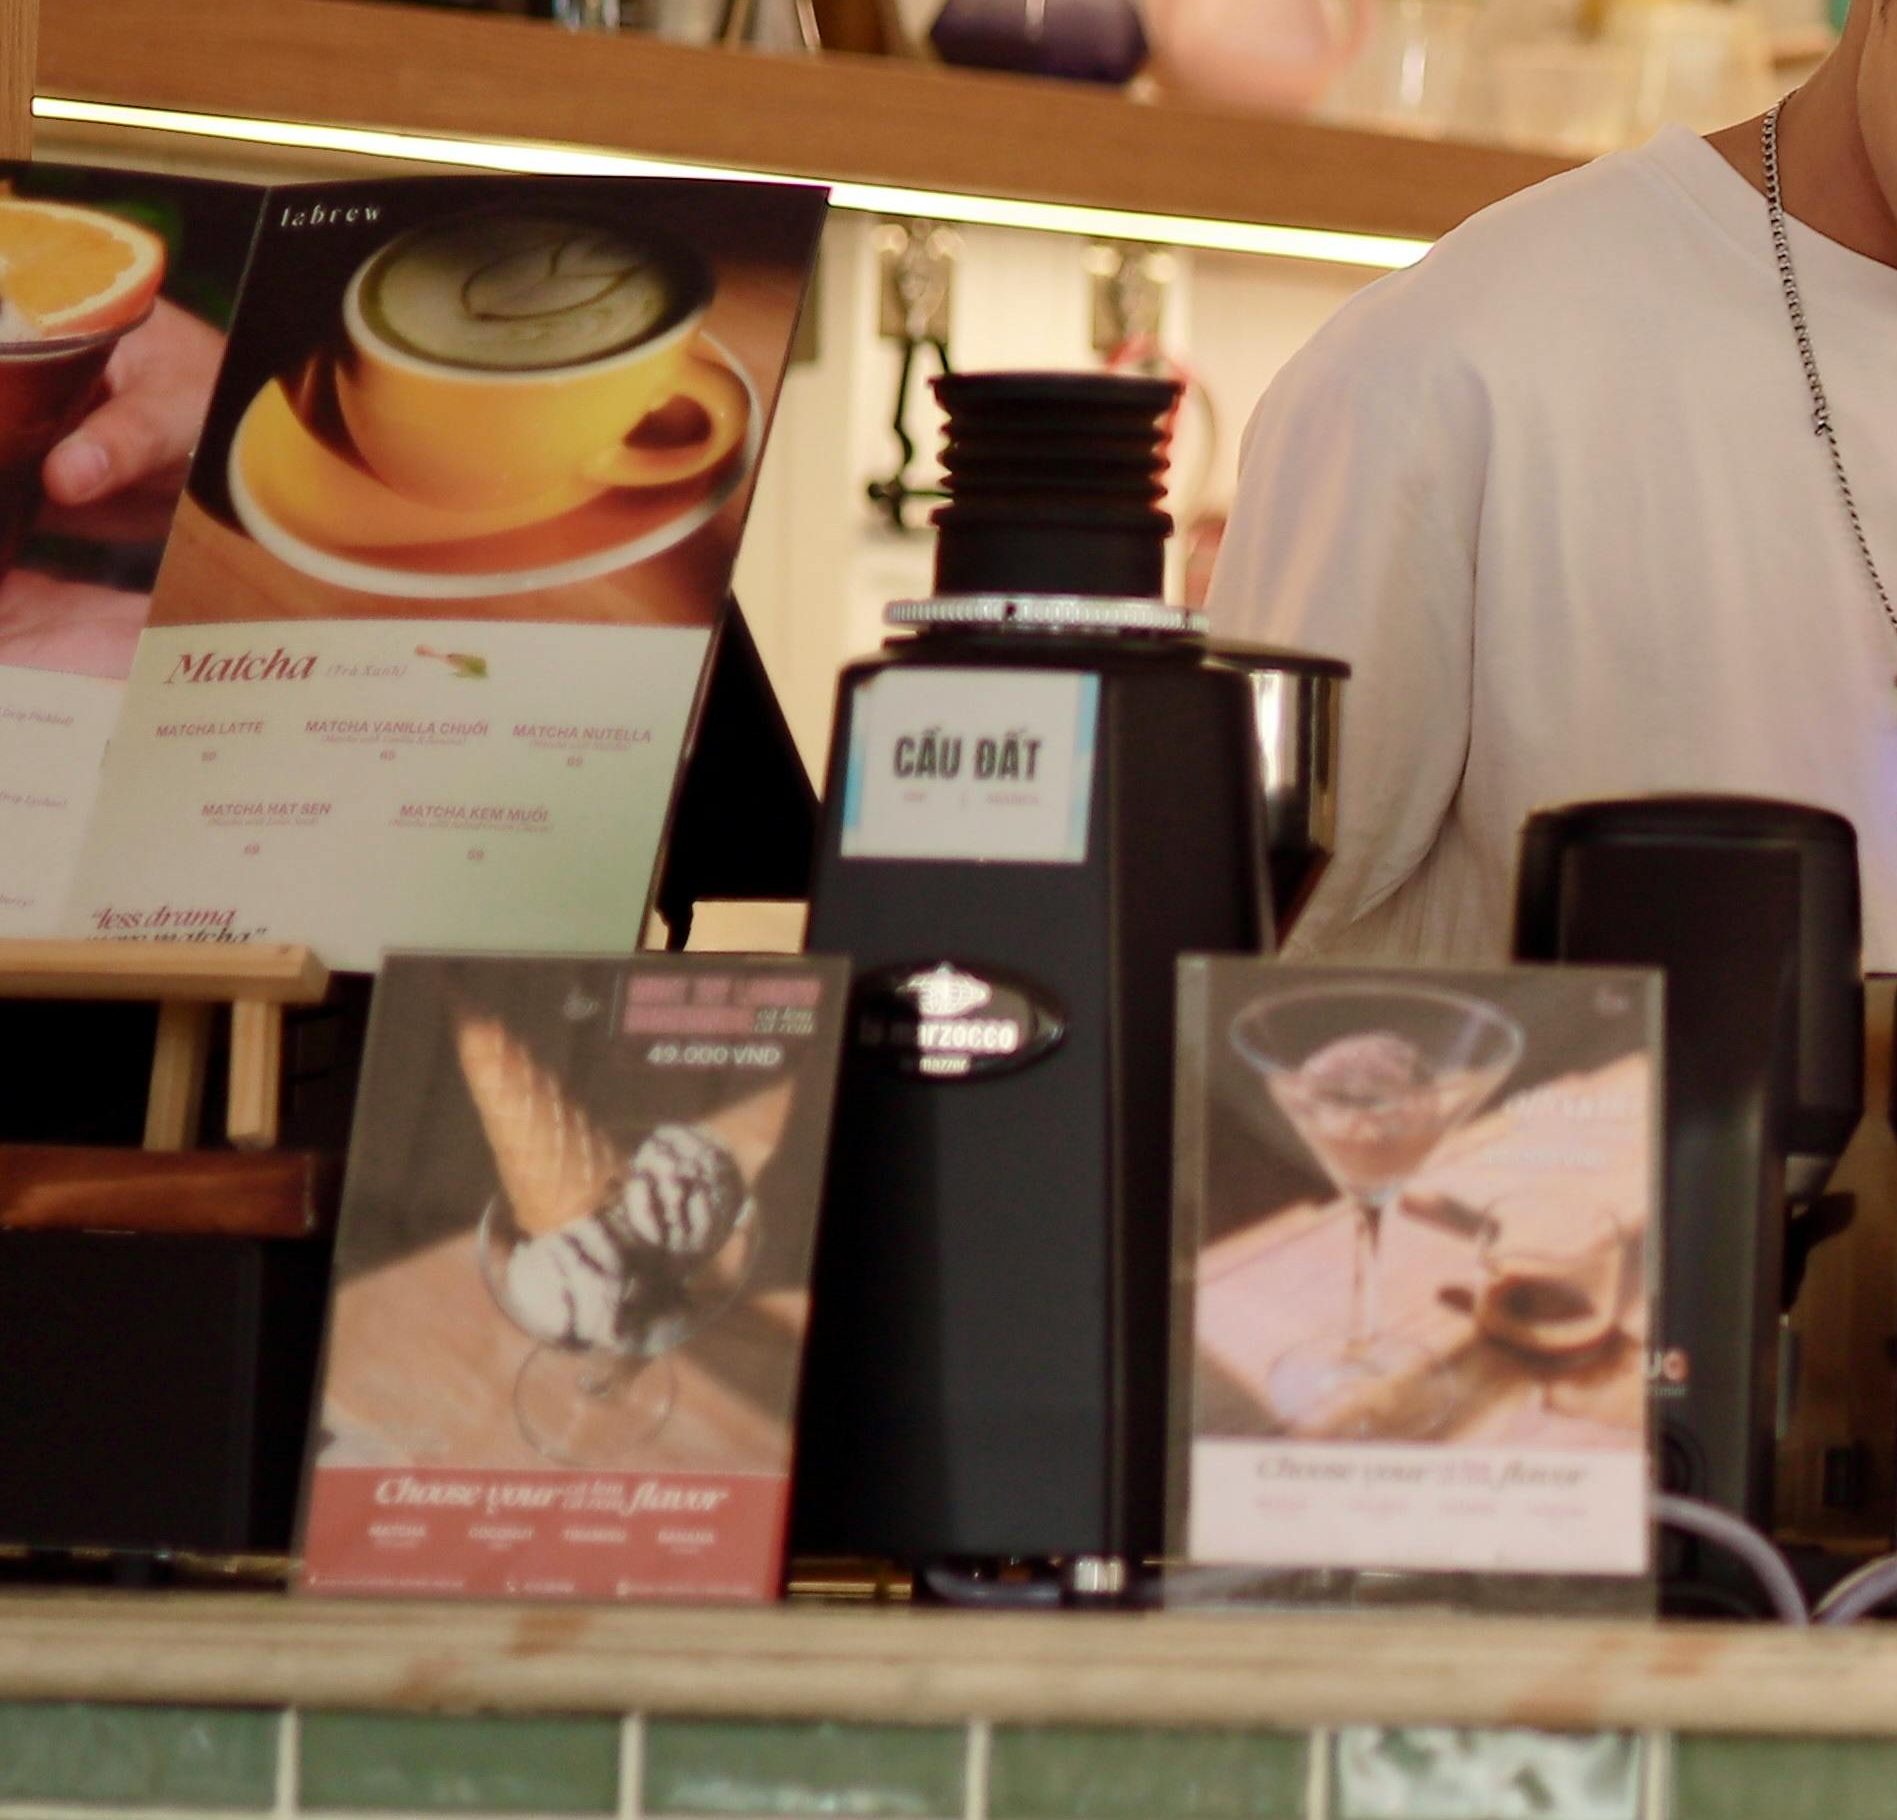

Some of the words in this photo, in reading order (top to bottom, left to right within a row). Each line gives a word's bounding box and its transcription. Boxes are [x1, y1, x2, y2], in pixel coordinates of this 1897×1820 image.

[281, 204, 380, 227] labrew
[162, 647, 319, 684] Matcha
[156, 722, 217, 737] MATCHA
[219, 720, 264, 734] LATTE
[305, 720, 368, 733] MATCHA
[374, 722, 436, 735] VANILLA
[512, 724, 578, 739] MATCHA
[583, 727, 651, 743] NUTELLA
[201, 803, 264, 817] MATCHA
[301, 802, 332, 816] SEN
[400, 803, 466, 819] MATCHA
[470, 806, 503, 821] KEM
[145, 904, 237, 929] drama
[733, 1044, 782, 1066] VND
[375, 1477, 482, 1507] Choose
[484, 1482, 563, 1515] your
